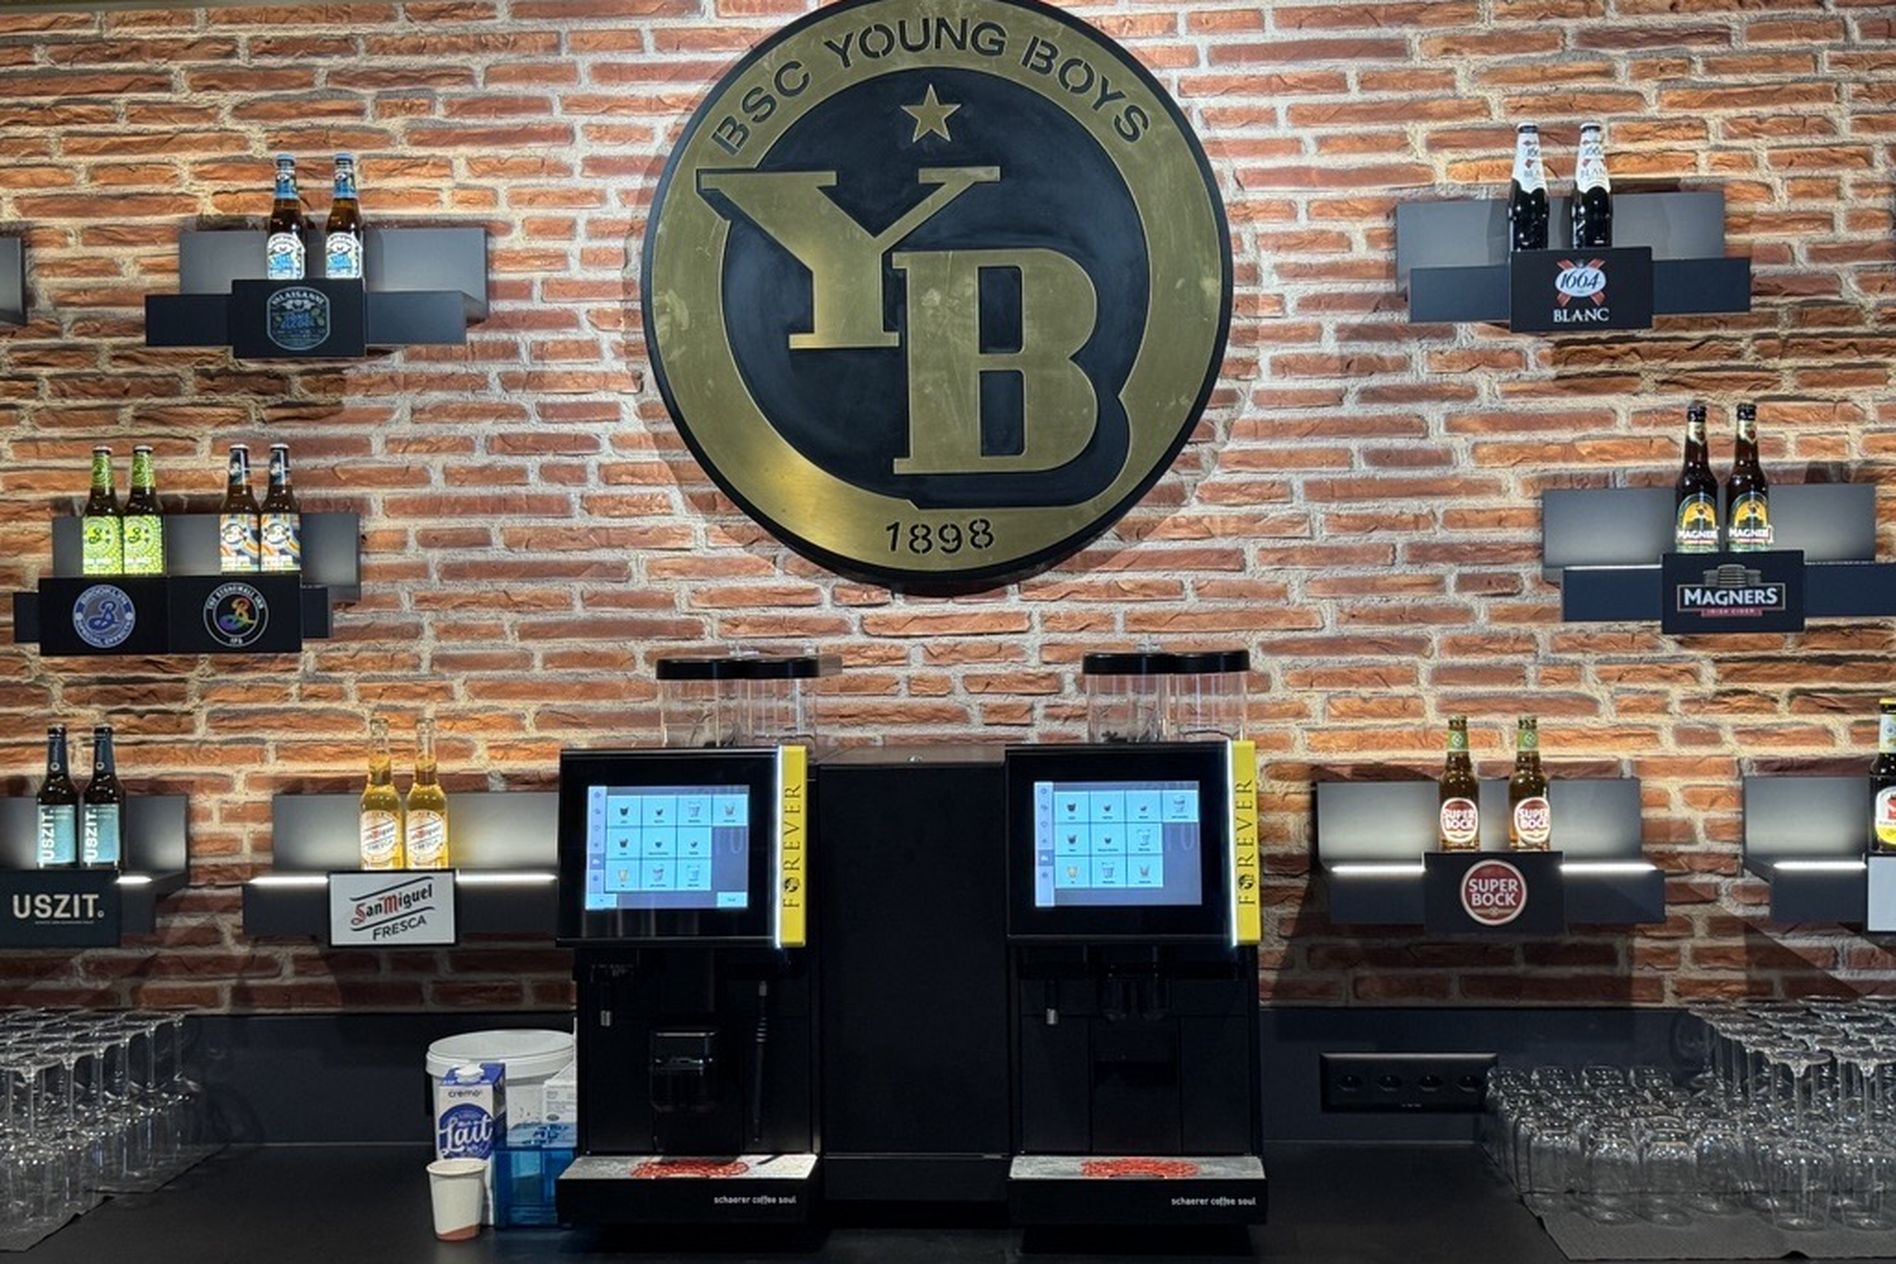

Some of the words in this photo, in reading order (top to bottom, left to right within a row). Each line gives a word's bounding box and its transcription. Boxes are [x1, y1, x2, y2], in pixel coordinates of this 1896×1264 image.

[710, 60, 810, 156] BSC
[824, 18, 1007, 69] YOUNG
[1021, 36, 1150, 145] BOYS
[1560, 270, 1600, 289] 1664
[1553, 307, 1610, 322] BLANC
[885, 519, 994, 553] 1898
[1684, 588, 1778, 606] MAGNERS
[1469, 879, 1518, 892] SUPER
[1471, 893, 1517, 906] BOCK
[372, 915, 427, 940] FRESCA
[439, 1113, 493, 1156] Lait
[1210, 1196, 1236, 1207] coffee
[1238, 1196, 1256, 1206] soul
